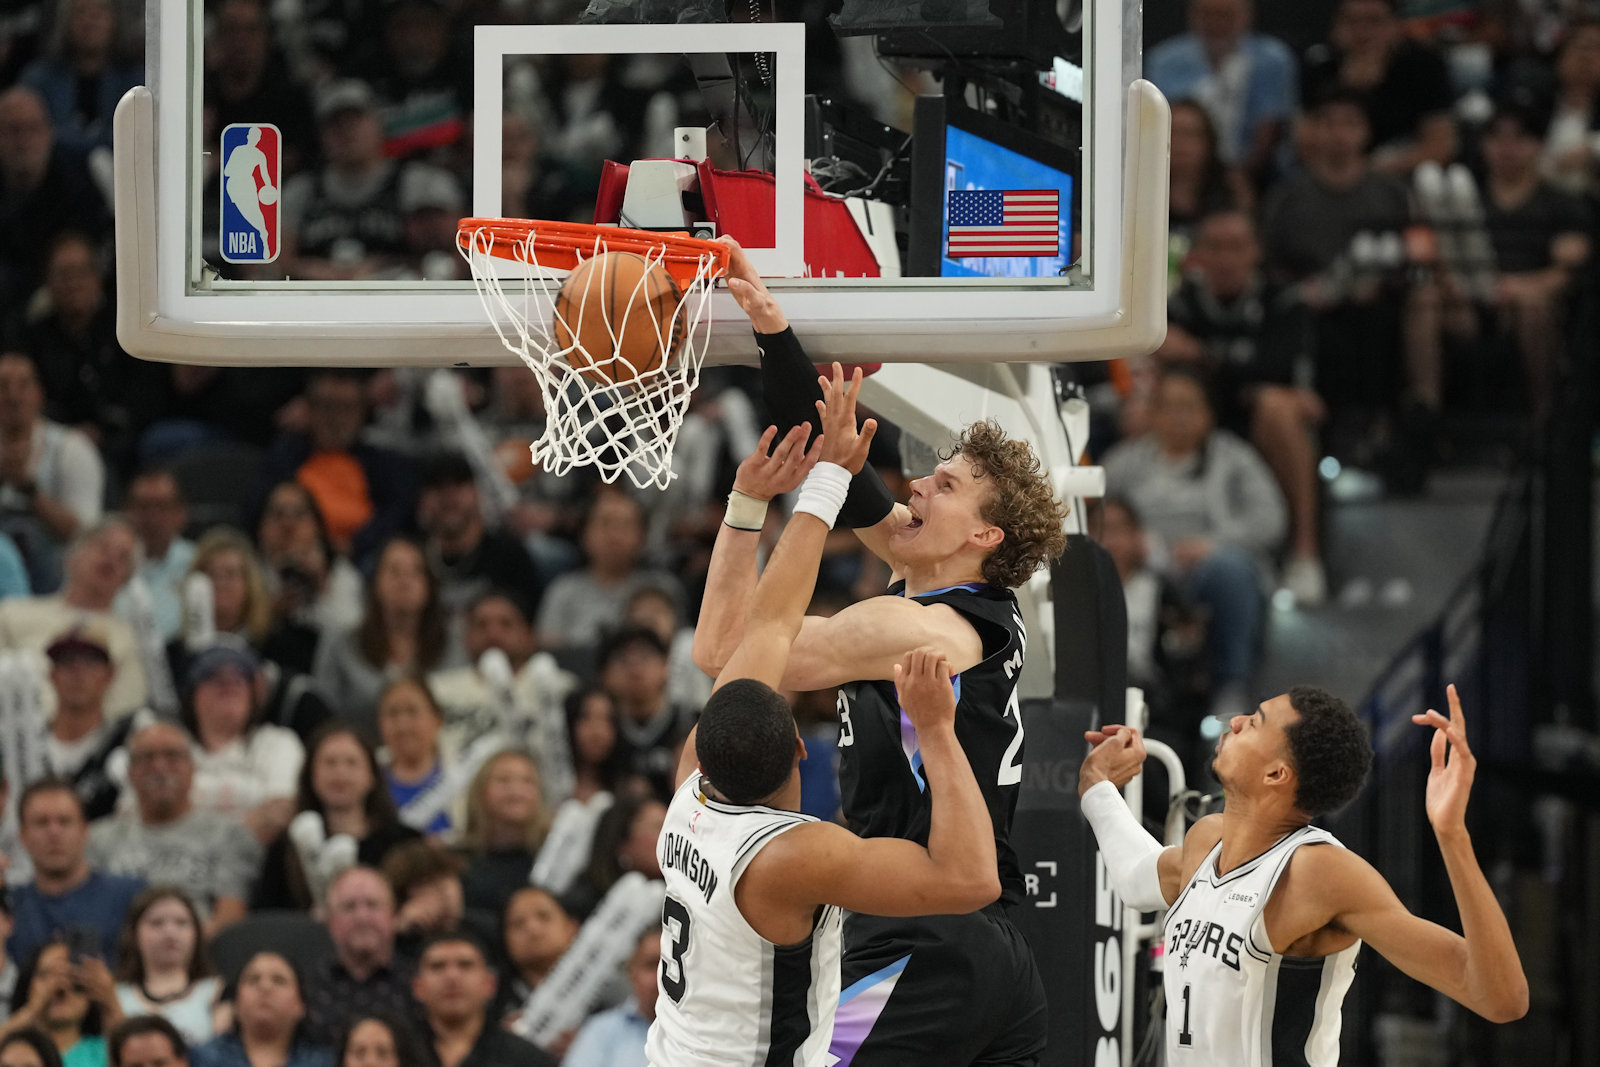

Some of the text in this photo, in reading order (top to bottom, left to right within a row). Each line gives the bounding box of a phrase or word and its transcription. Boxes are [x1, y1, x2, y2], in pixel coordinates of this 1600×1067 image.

[229, 232, 257, 254] NBA
[837, 689, 854, 747] 3
[662, 832, 719, 905] JOHNSON
[1228, 892, 1253, 903] LEDGER
[661, 893, 694, 1006] 3
[1168, 918, 1245, 972] SPURS
[1178, 984, 1193, 1048] 1
